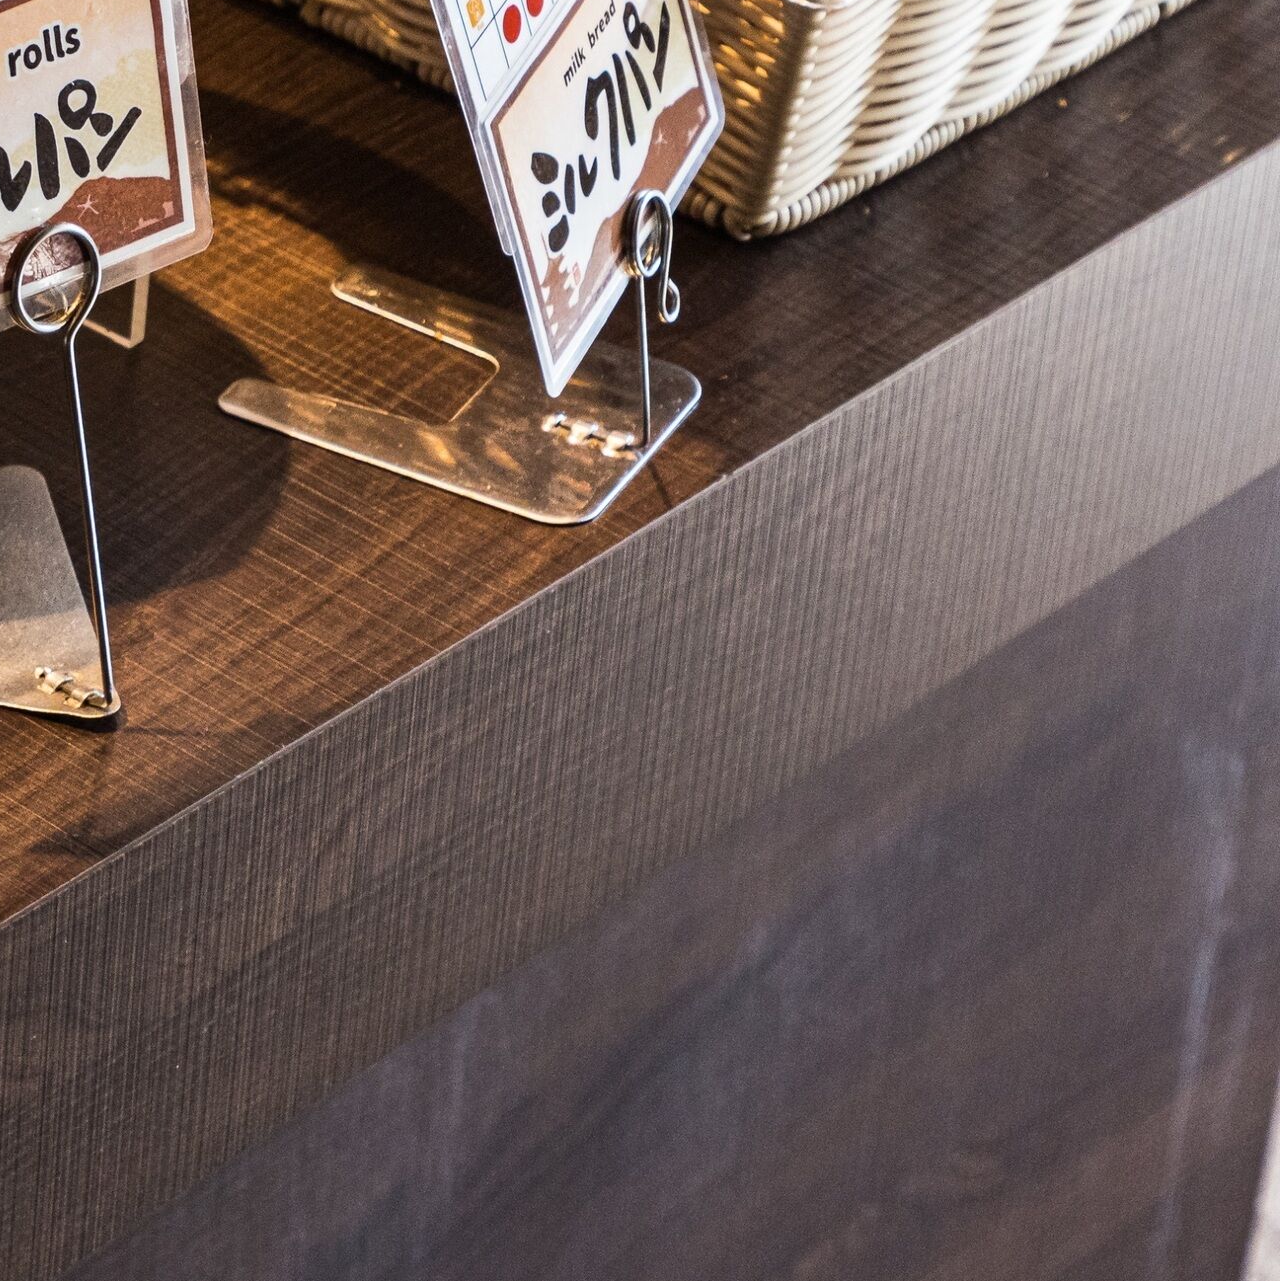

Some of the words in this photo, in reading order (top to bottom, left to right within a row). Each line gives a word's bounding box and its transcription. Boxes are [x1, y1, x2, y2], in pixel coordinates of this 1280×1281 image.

[8, 24, 81, 77] rolls
[563, 47, 587, 87] milk
[531, 1, 670, 253] ミルクパン
